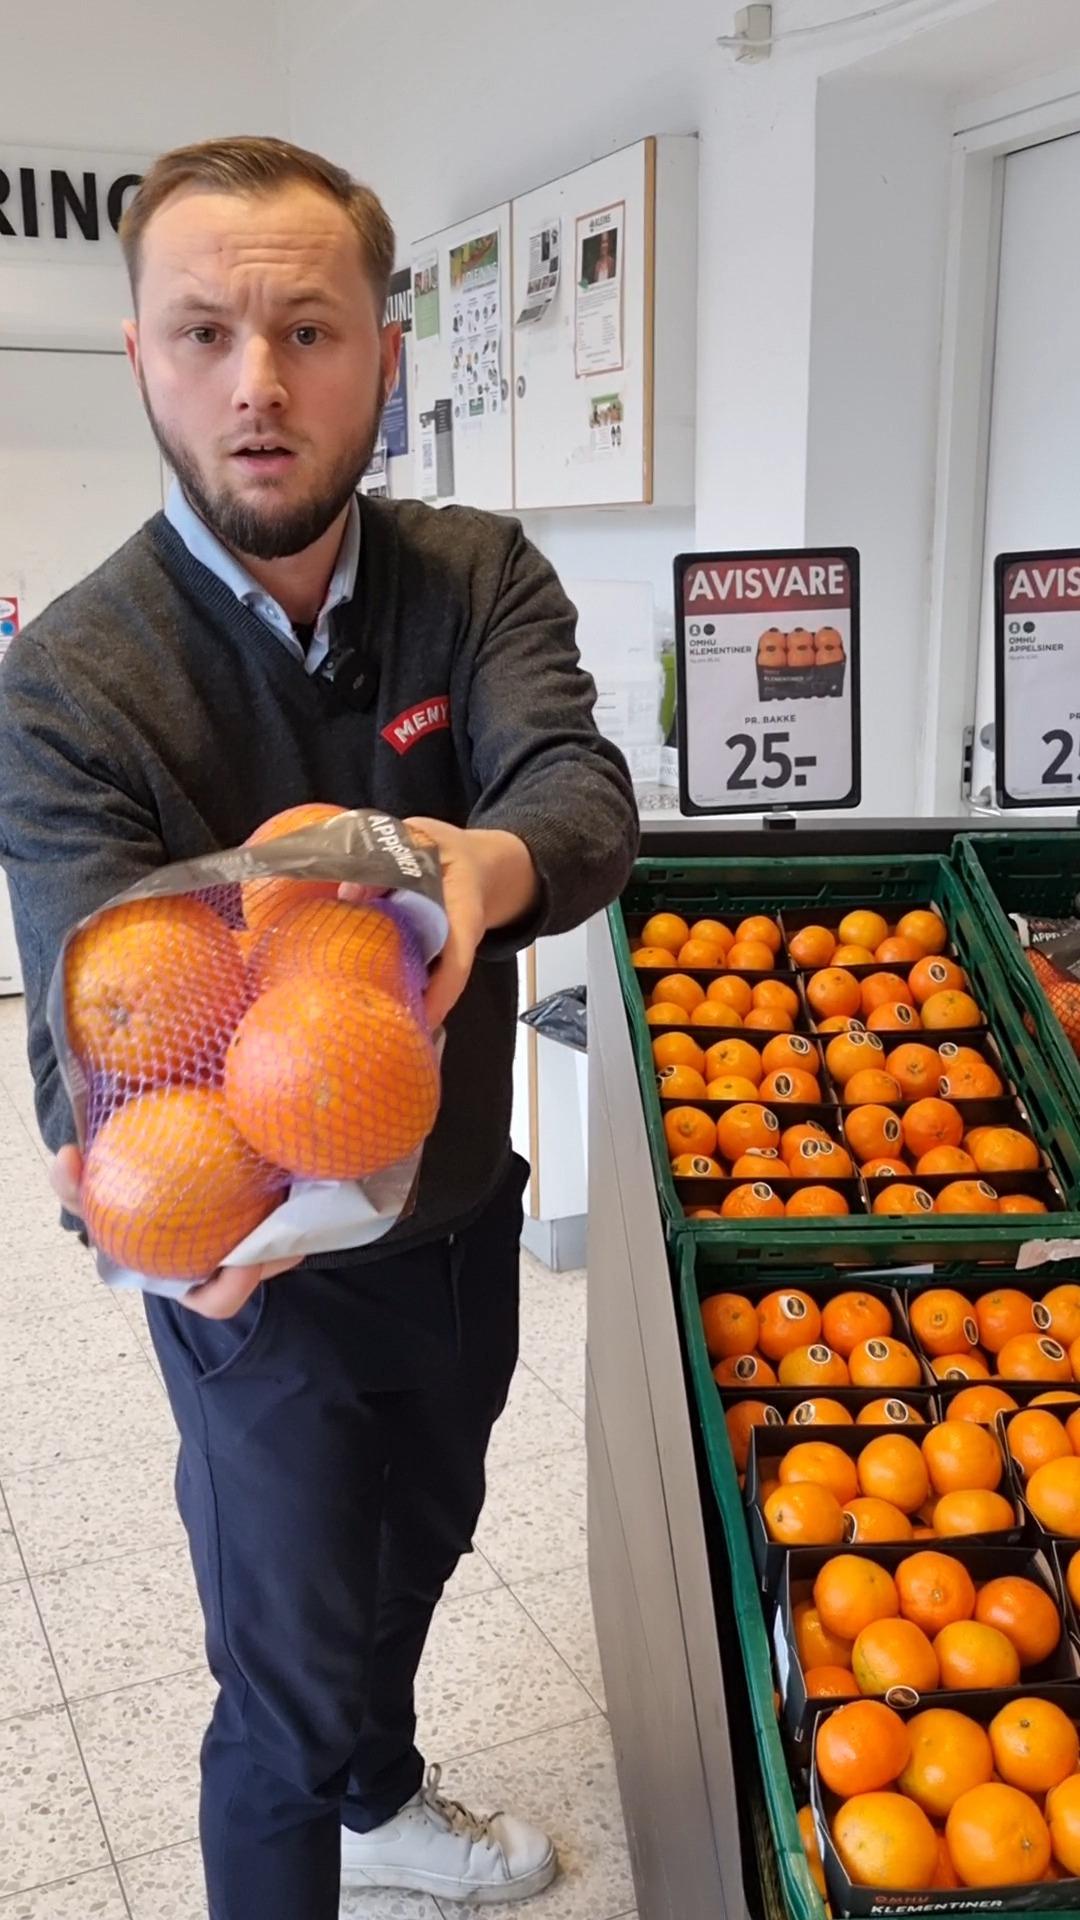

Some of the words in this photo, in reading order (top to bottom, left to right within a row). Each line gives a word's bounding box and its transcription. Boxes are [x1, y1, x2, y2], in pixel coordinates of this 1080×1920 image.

[688, 564, 844, 601] AVISVARE
[689, 639, 716, 647] OMHU
[1009, 636, 1036, 644] OMHU
[689, 646, 752, 656] KLEMENTINER
[1009, 644, 1064, 653] APPELSINER
[393, 703, 449, 744] MENY
[744, 716, 761, 724] PR.
[763, 714, 797, 724] BAKKE
[1041, 729, 1080, 785] 2
[870, 1899, 1004, 1914] KLEMENTINER
